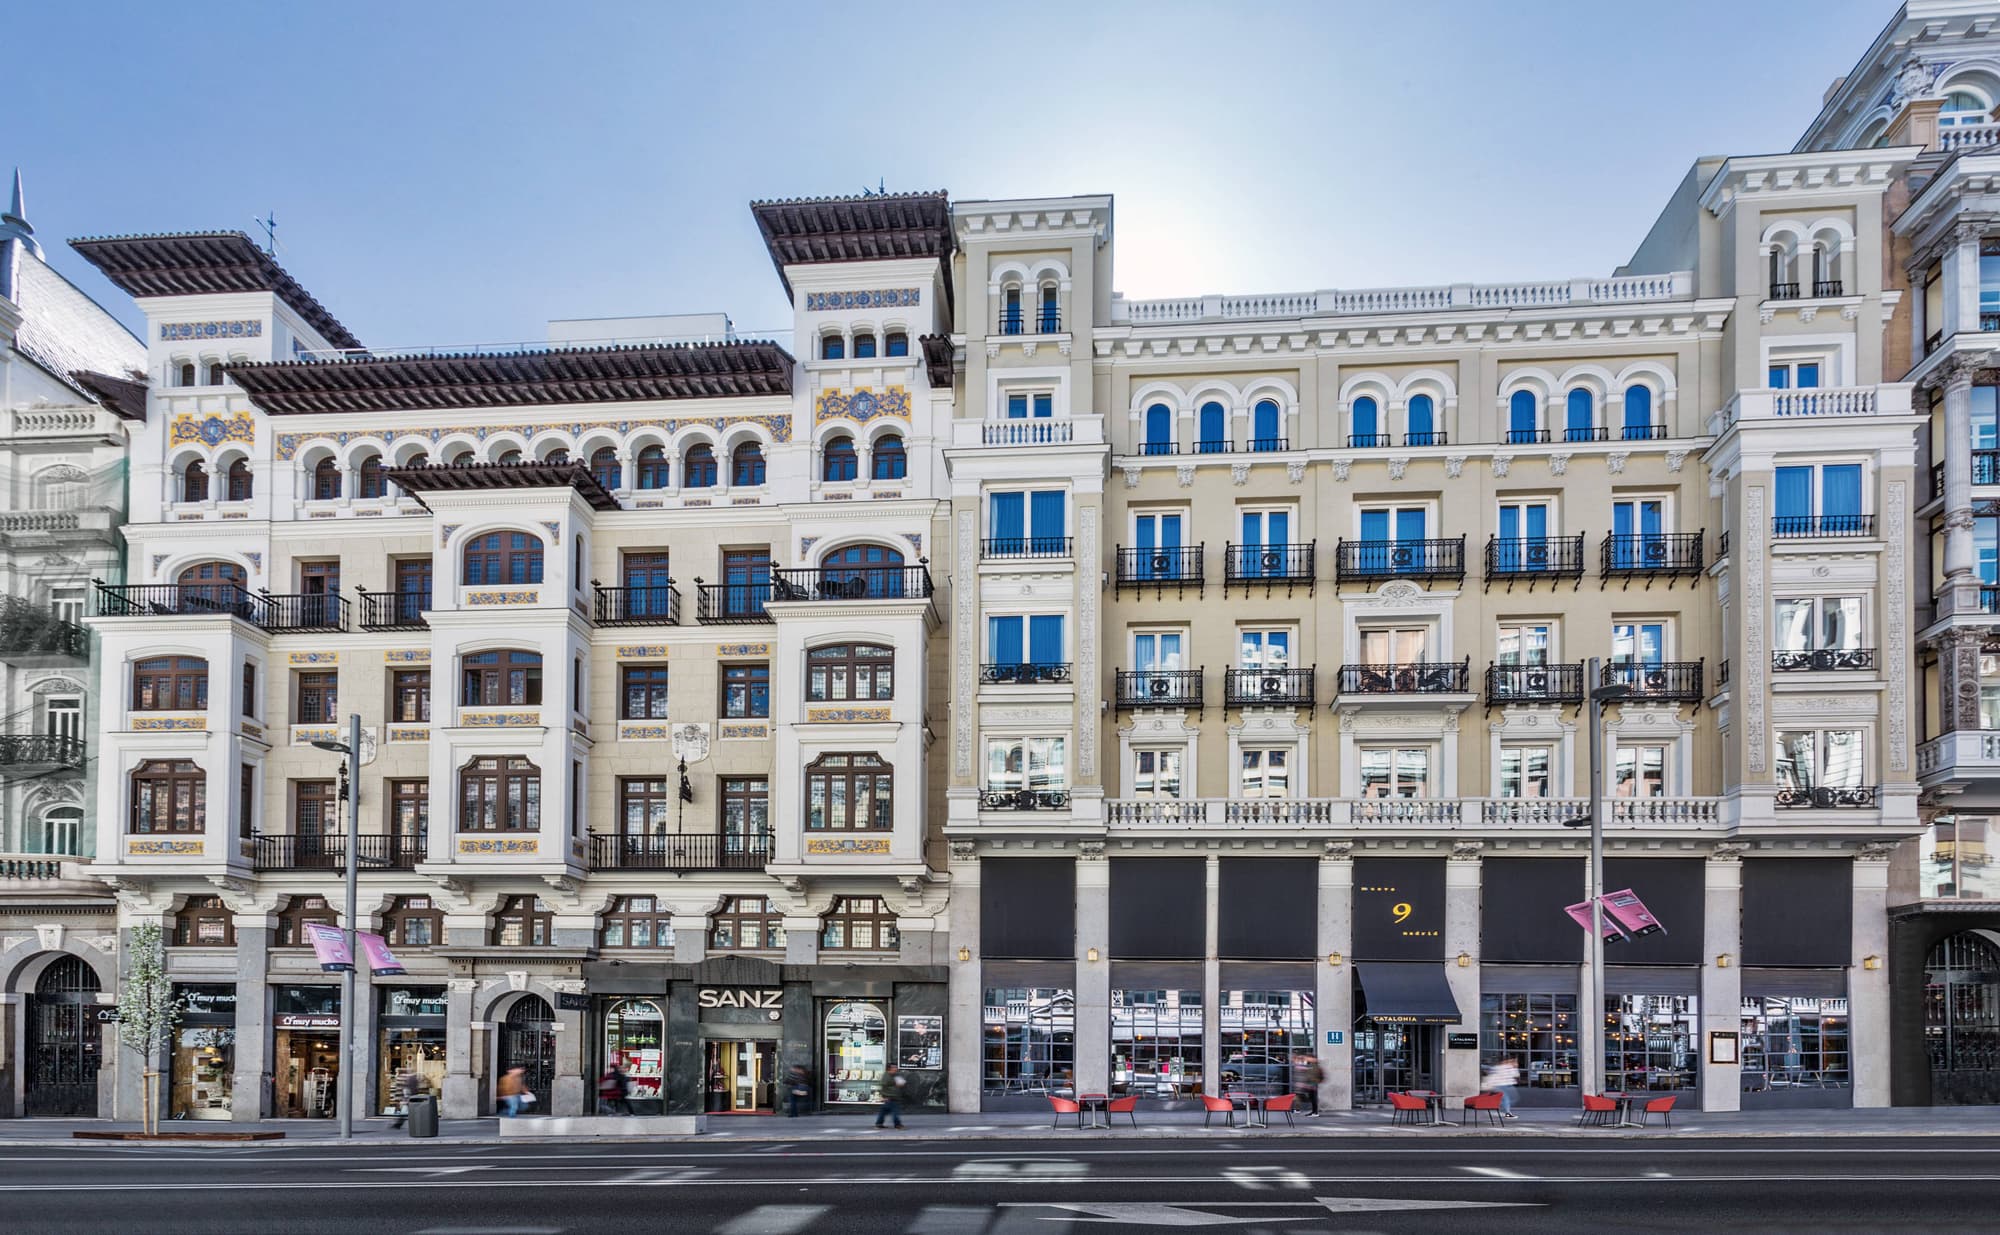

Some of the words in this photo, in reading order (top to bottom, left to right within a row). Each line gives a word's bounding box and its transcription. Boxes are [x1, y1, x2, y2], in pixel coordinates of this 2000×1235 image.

[1392, 902, 1412, 924] 9
[197, 995, 215, 1003] muy
[403, 998, 421, 1006] muy
[698, 989, 783, 1009] SANZ
[311, 1018, 339, 1026] mucho
